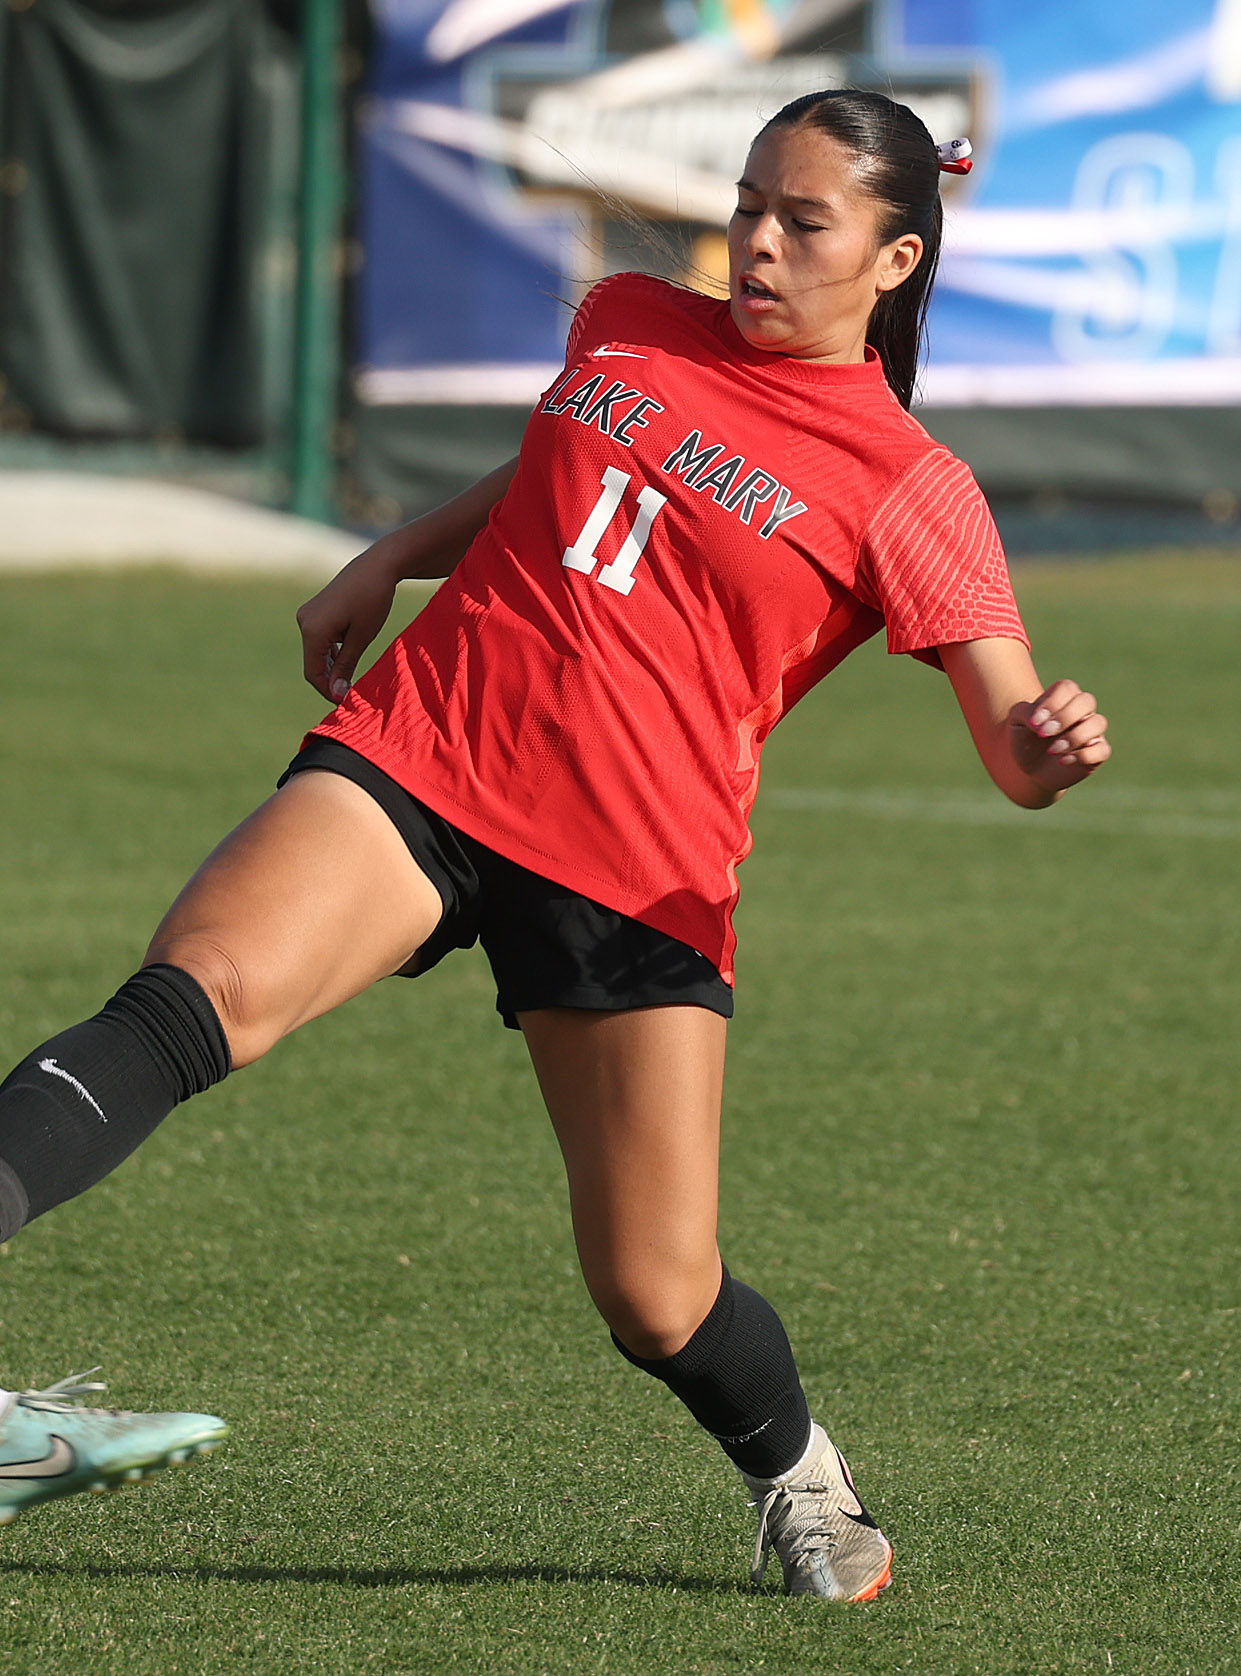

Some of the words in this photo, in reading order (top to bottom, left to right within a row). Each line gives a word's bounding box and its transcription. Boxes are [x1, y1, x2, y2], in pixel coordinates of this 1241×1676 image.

[540, 368, 665, 447] LAKE
[661, 429, 809, 540] MARY
[561, 465, 669, 596] 11
